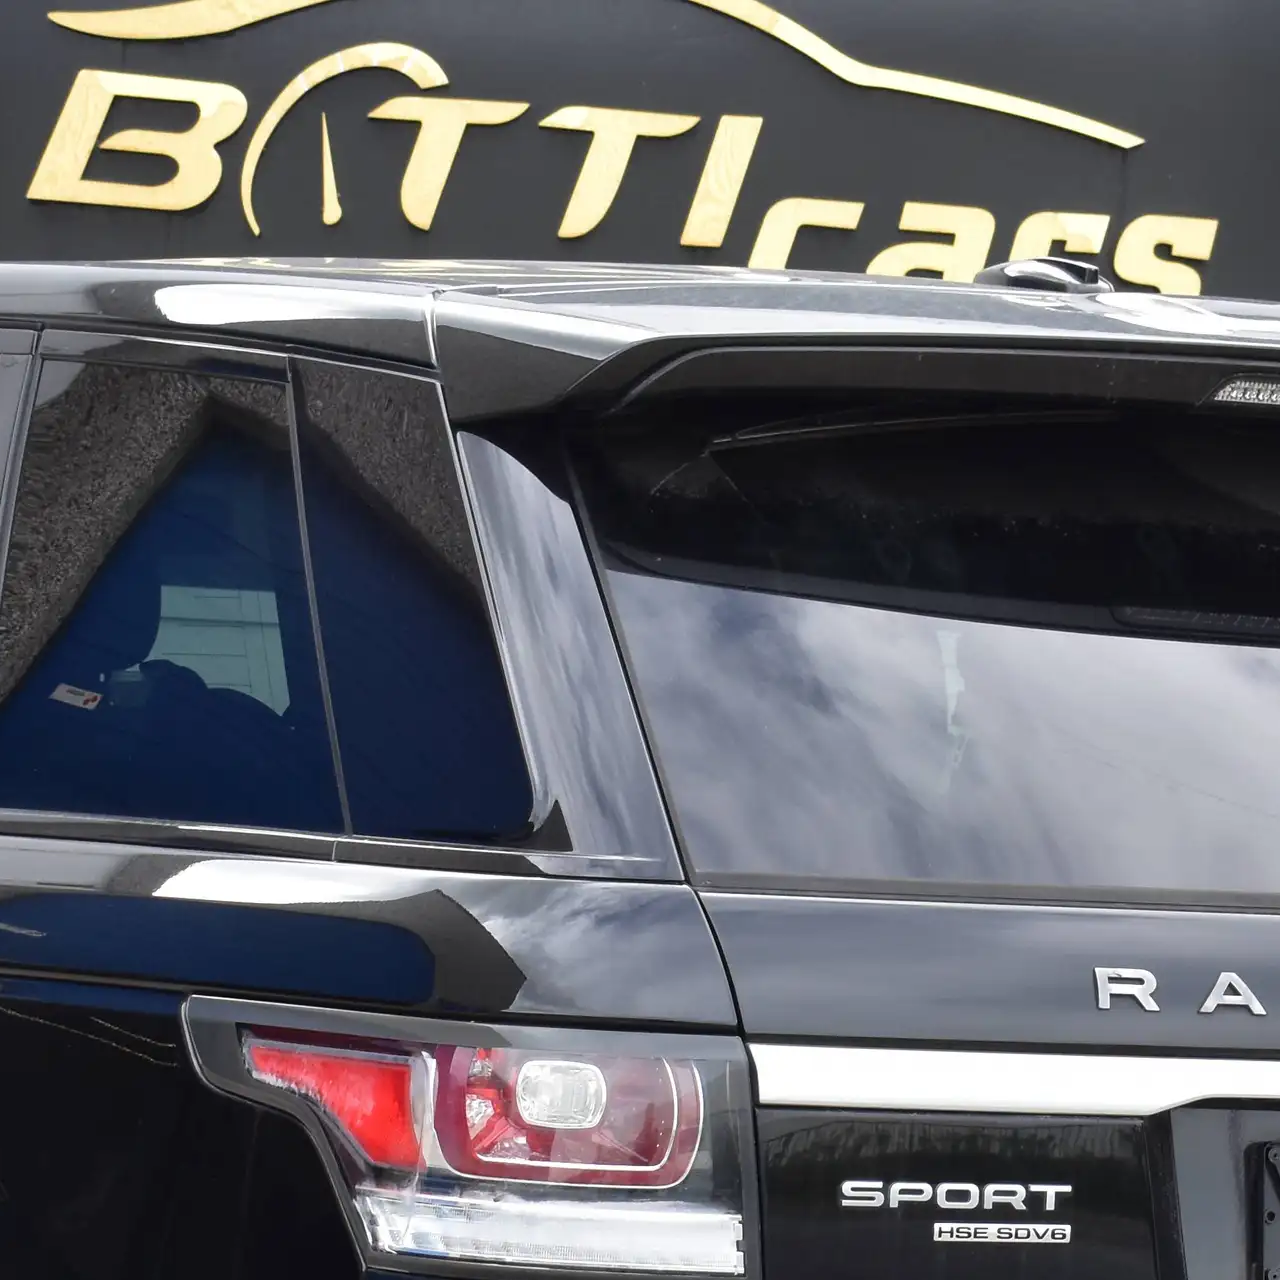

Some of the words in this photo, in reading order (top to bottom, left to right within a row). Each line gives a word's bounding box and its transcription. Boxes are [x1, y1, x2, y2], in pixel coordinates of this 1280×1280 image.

[841, 1180, 1072, 1211] SPORT
[937, 1226, 989, 1240] HSE
[996, 1228, 1068, 1240] SDV6
